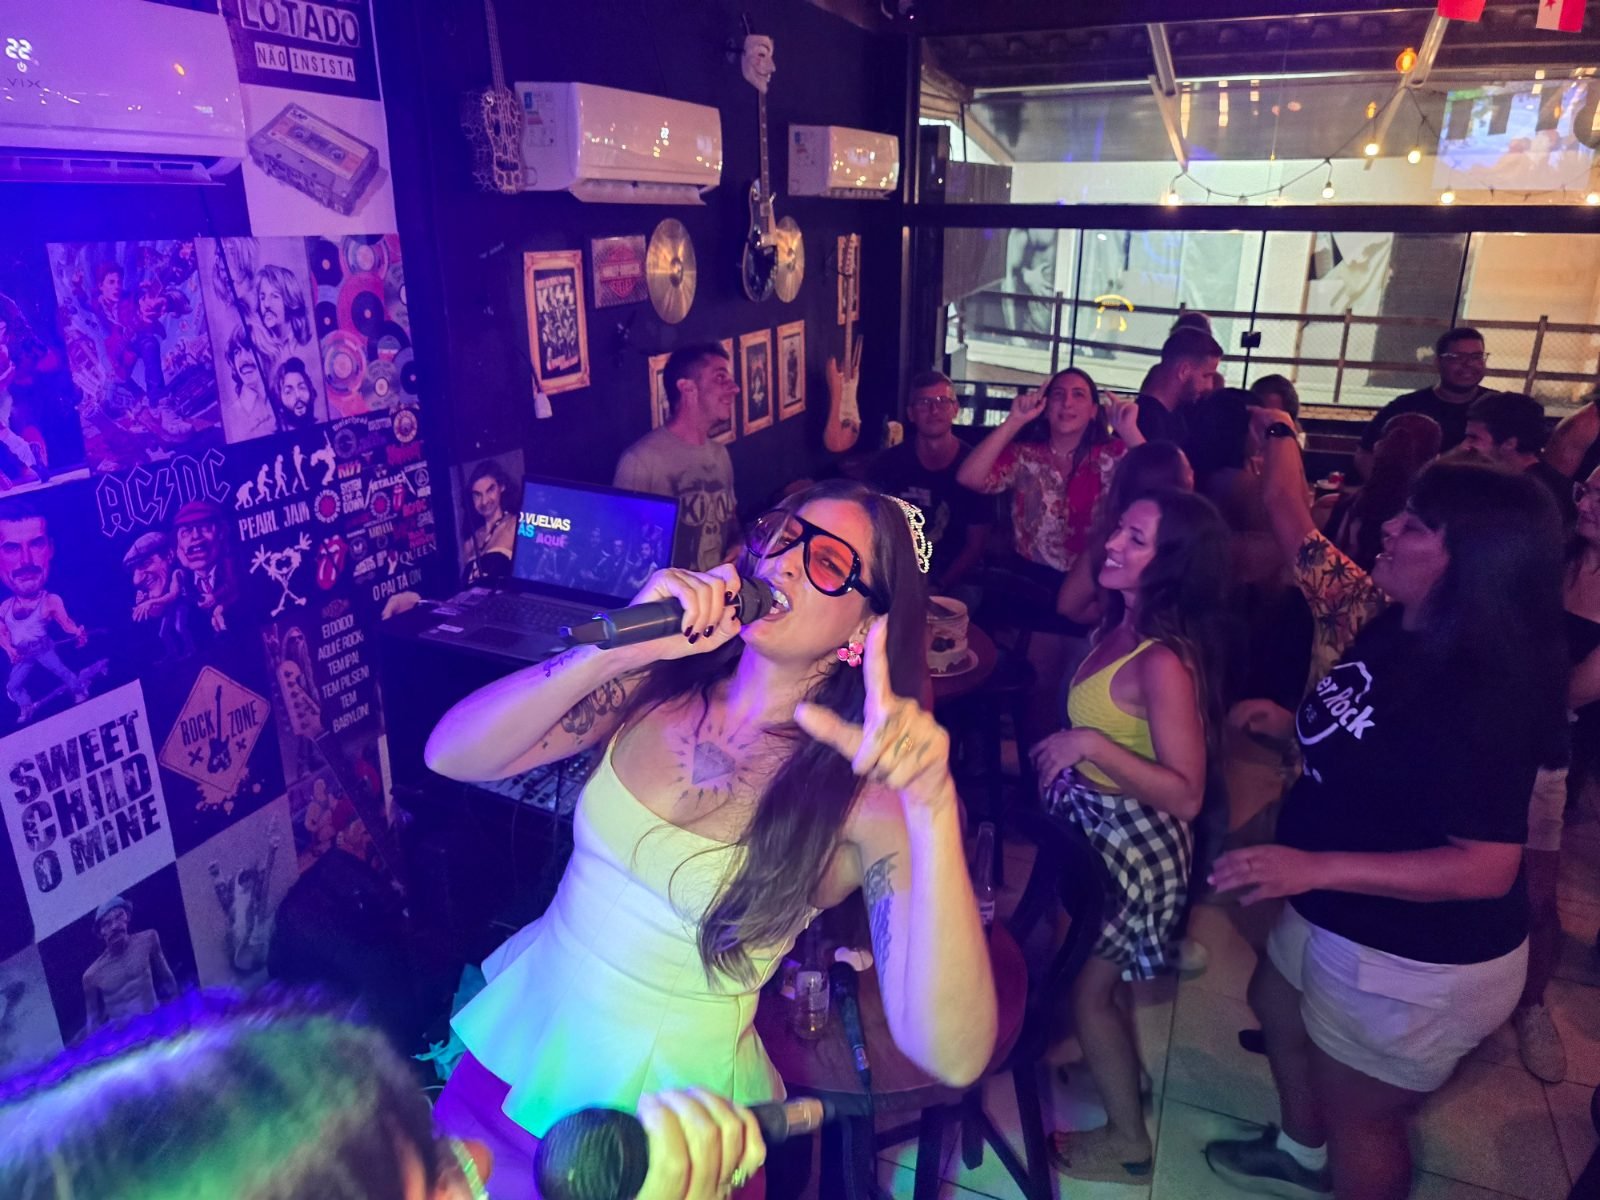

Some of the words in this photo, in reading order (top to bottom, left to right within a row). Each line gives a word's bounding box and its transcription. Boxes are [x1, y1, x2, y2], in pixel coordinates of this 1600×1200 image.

[241, 0, 360, 47] LOTADO
[5, 38, 33, 60] 22
[257, 45, 287, 67] NÃO
[292, 53, 354, 78] INSISTA
[239, 509, 280, 541] PEARL
[283, 501, 311, 528] JAM
[525, 512, 571, 532] VUELVAS
[399, 542, 437, 566] QUEEN
[380, 578, 396, 598] PAI
[181, 709, 216, 747] ROCK
[227, 699, 260, 739] ZONE
[9, 709, 140, 806] SWEET
[21, 753, 153, 852] CHILD
[33, 849, 63, 894] O
[69, 794, 162, 876] MINE
